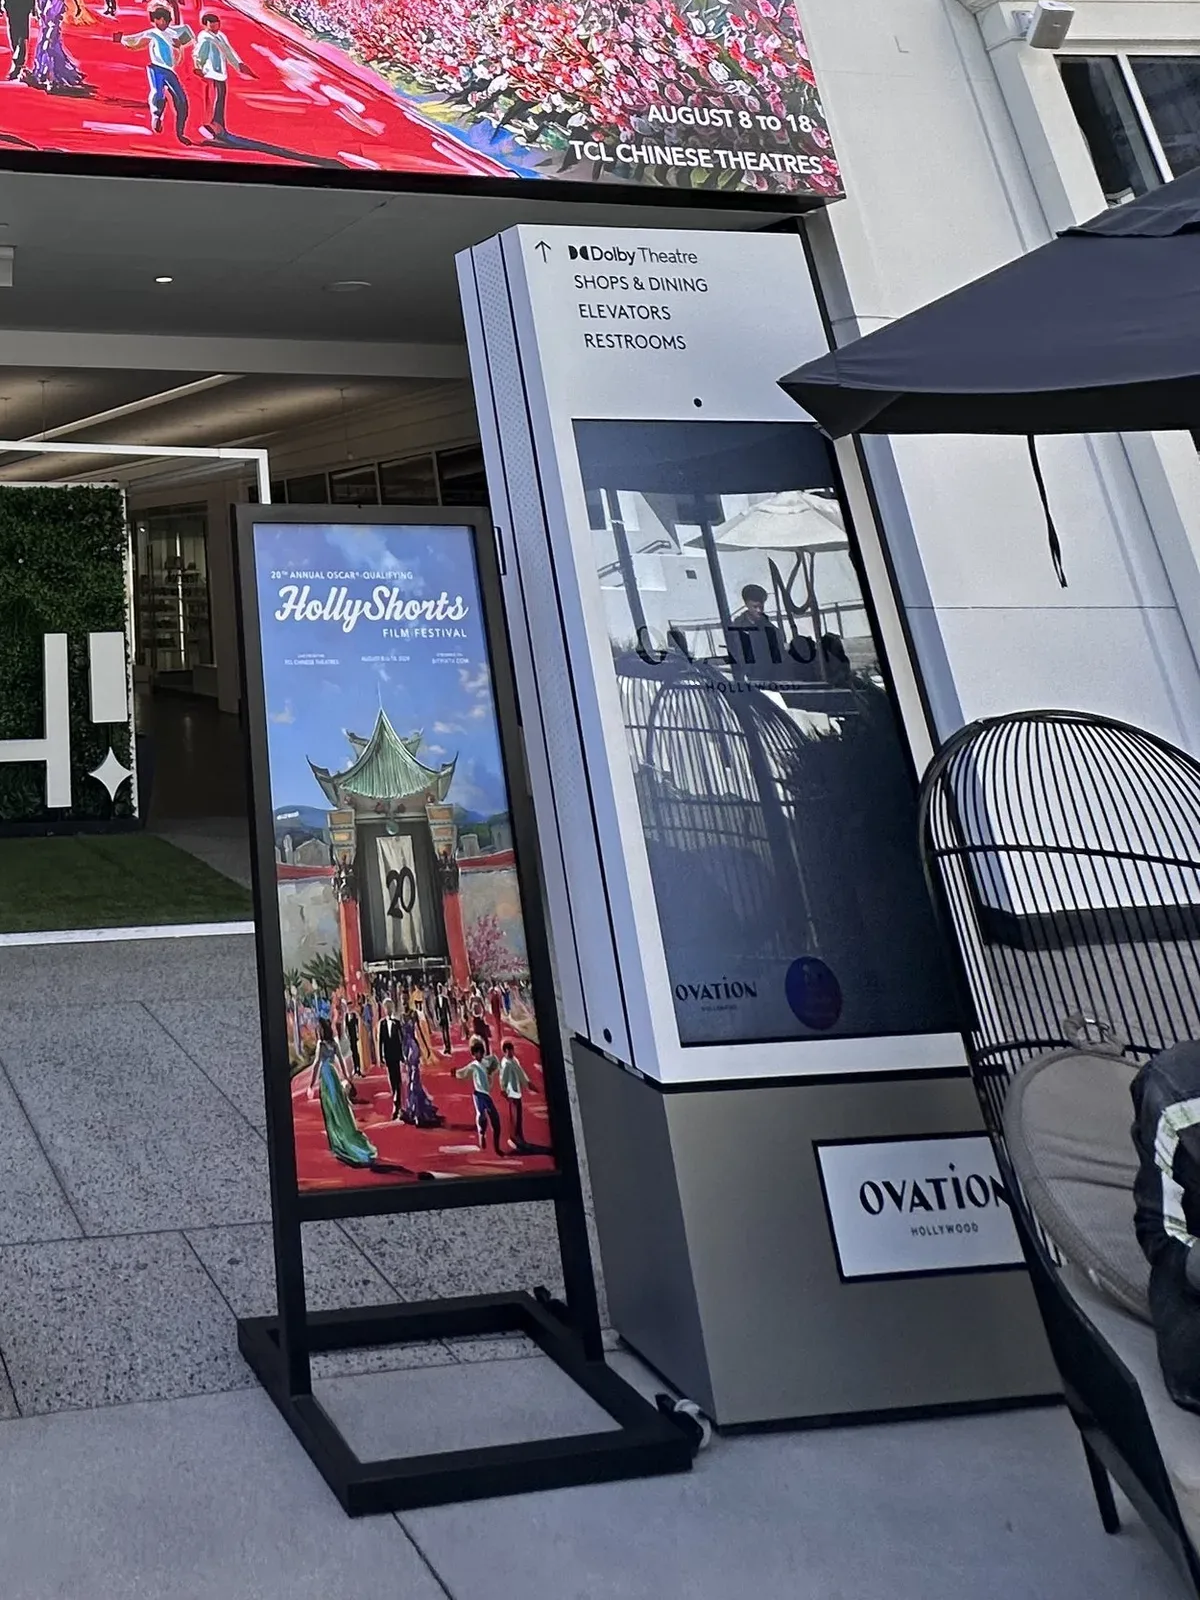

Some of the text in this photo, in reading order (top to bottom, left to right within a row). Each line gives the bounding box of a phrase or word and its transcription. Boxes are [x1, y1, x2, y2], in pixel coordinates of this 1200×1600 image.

[649, 105, 733, 128] AUGUST
[739, 110, 753, 129] 8
[786, 115, 813, 133] 18
[569, 140, 824, 174] TCL CHINESE THEATRES
[590, 246, 698, 265] Dolby Theatre
[574, 275, 708, 292] SHOPS & DINING
[578, 304, 671, 320] ELEVATORS
[584, 333, 686, 350] RESTROOMS
[290, 571, 325, 580] ANNUAL
[275, 585, 469, 633] HollyShorts
[383, 628, 467, 638] FILM FESTIVAL
[386, 866, 416, 920] 20
[675, 975, 758, 1001] OVATION
[911, 1222, 979, 1236] HOLLYWOOD
